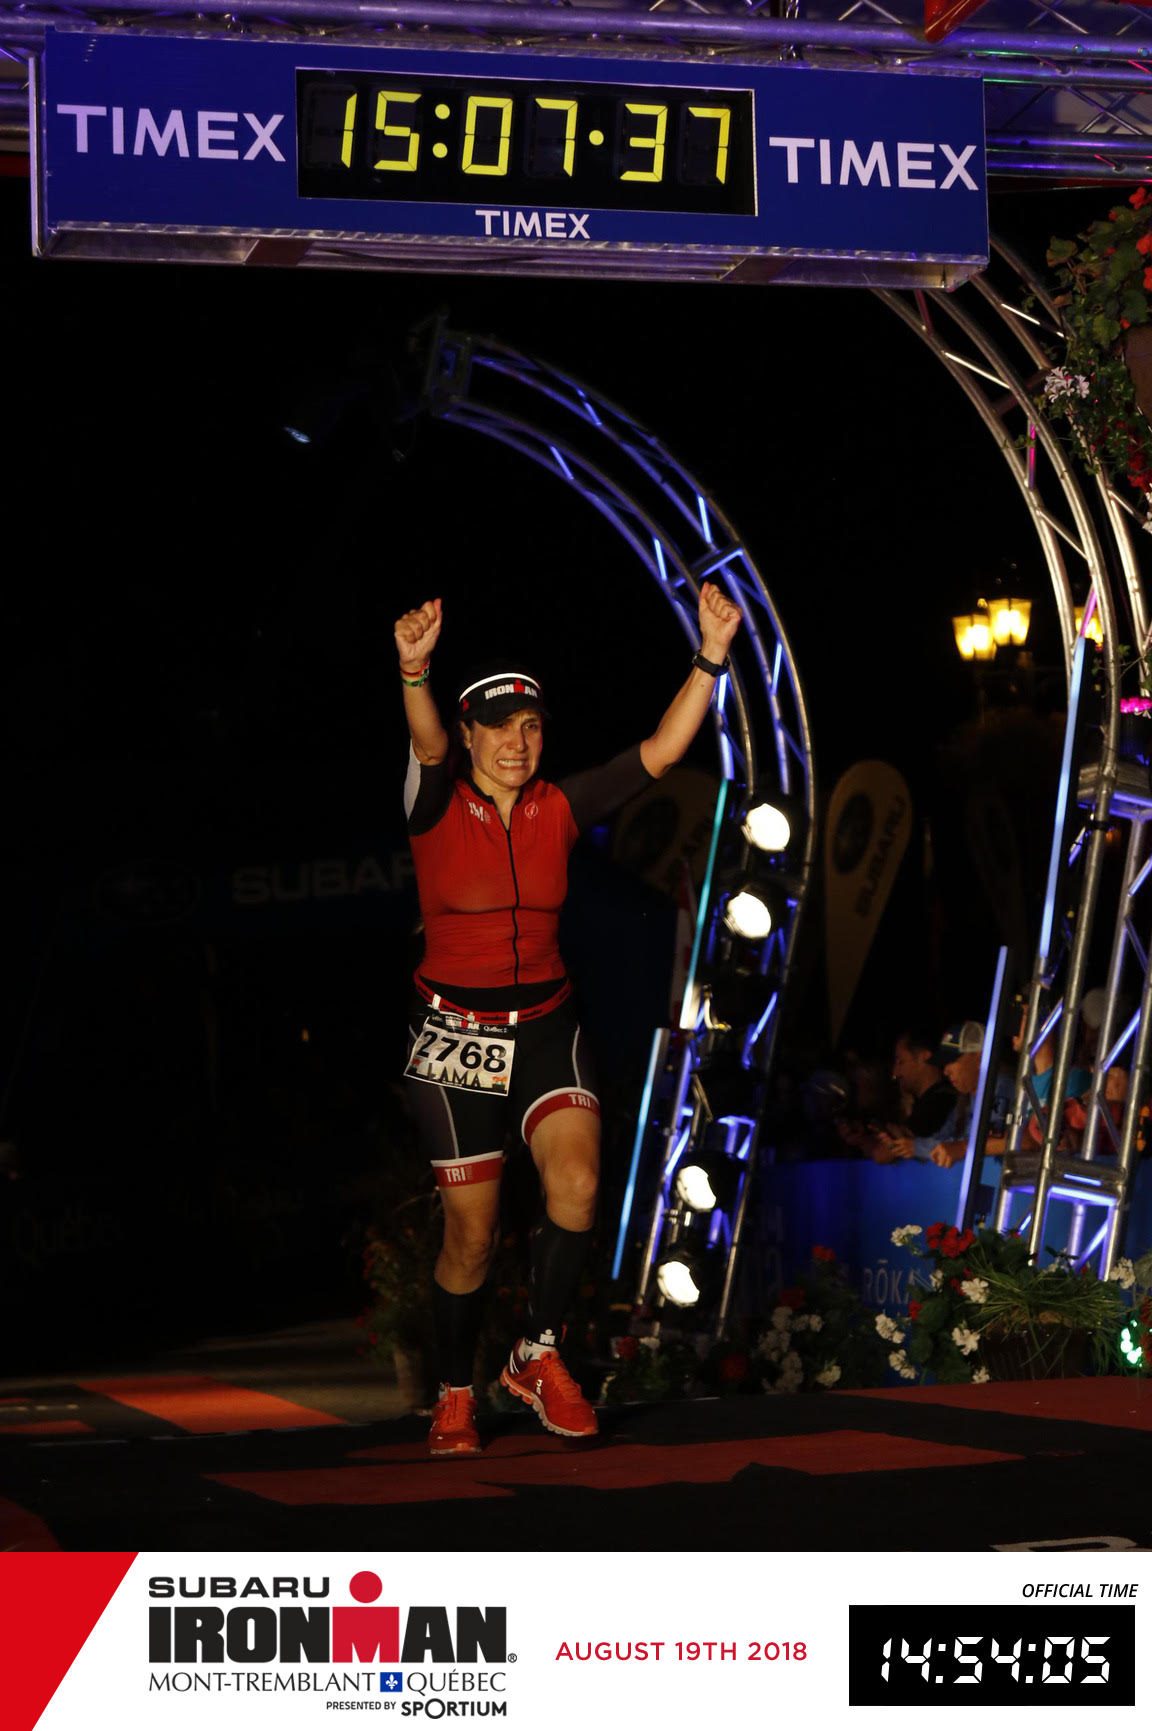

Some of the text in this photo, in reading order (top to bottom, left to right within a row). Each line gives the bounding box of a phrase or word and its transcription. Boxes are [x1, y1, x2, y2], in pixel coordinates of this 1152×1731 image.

[57, 105, 286, 162] TIMEX
[769, 137, 979, 190] TIMEX
[475, 209, 591, 239] TIMEX
[484, 683, 538, 700] IRONMAN
[416, 1031, 506, 1072] 2768
[427, 1062, 482, 1088] LAMA
[568, 1094, 591, 1108] TRI
[444, 1166, 466, 1183] TRI
